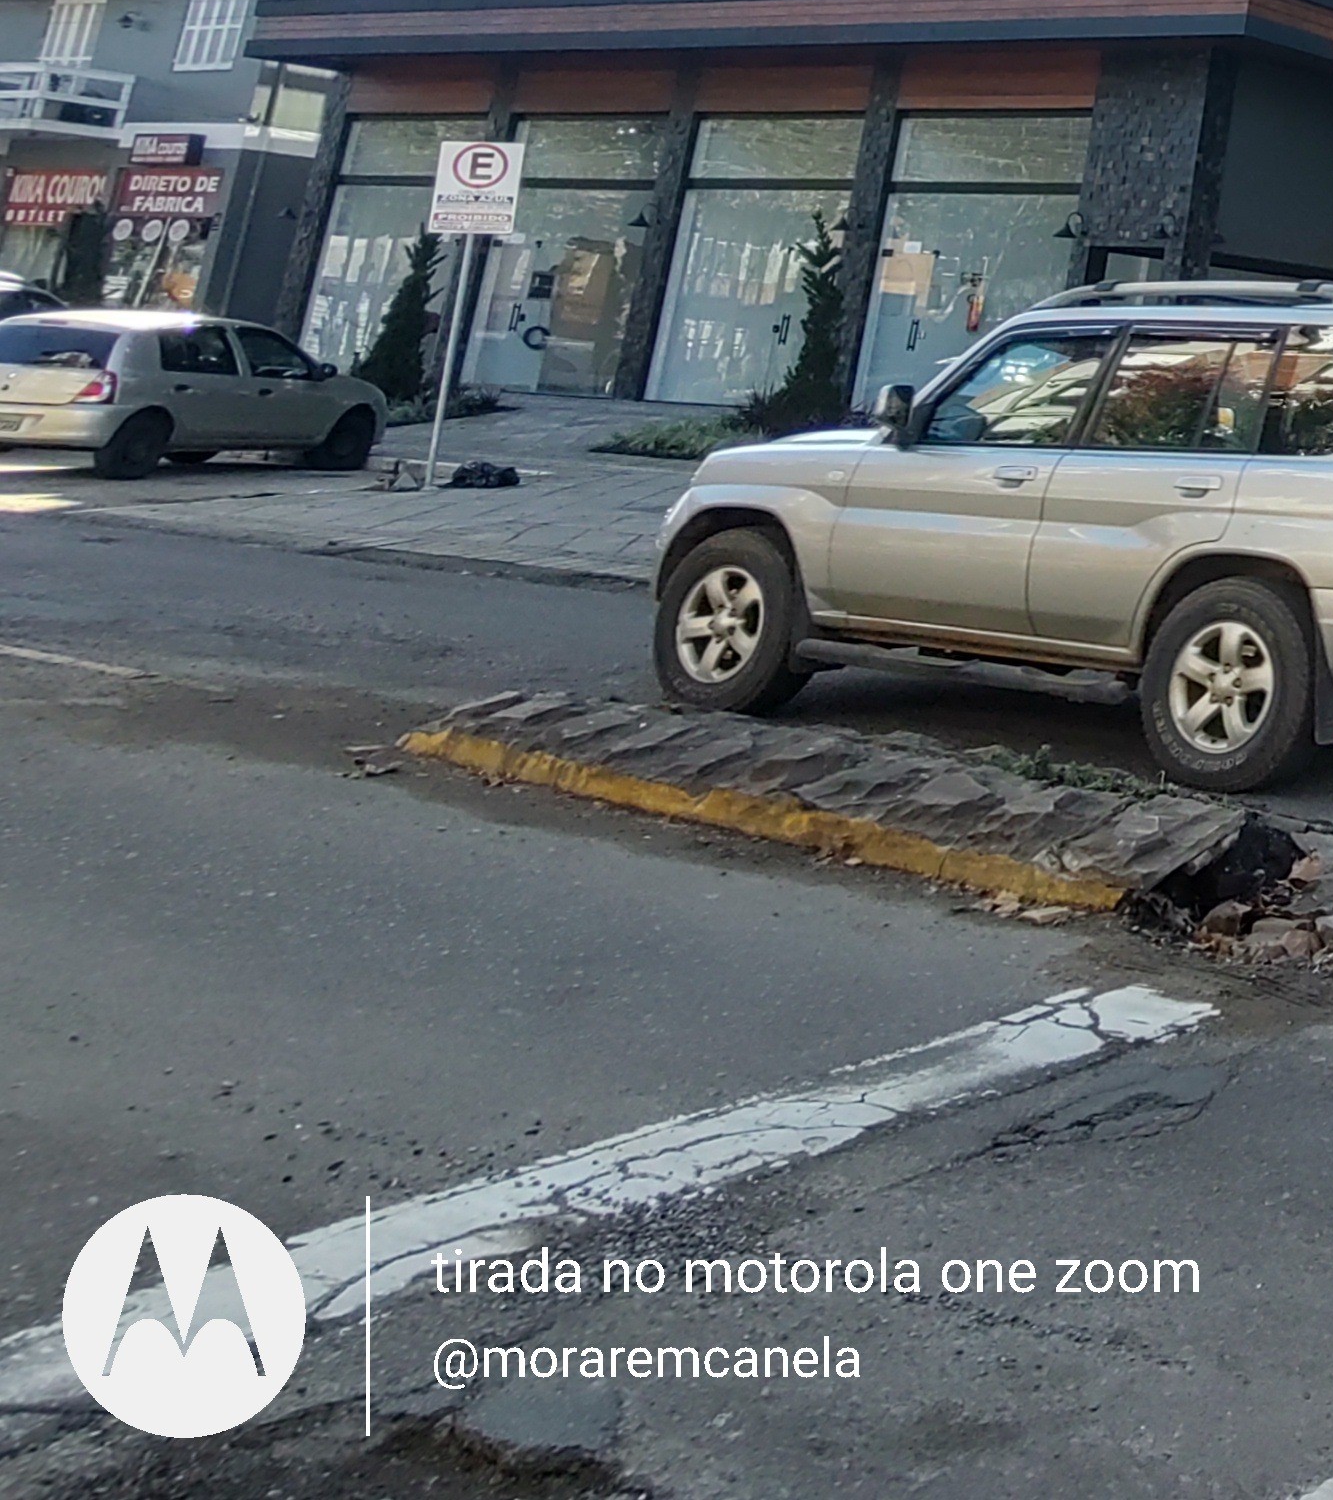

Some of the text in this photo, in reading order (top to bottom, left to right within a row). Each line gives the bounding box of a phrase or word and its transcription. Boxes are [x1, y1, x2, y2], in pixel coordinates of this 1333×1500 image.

[469, 152, 495, 180] E
[129, 175, 220, 193] DIRETO DE
[440, 194, 511, 203] ZONA AZUL
[5, 209, 66, 223] OUTLET
[438, 213, 508, 222] PROIBIDO
